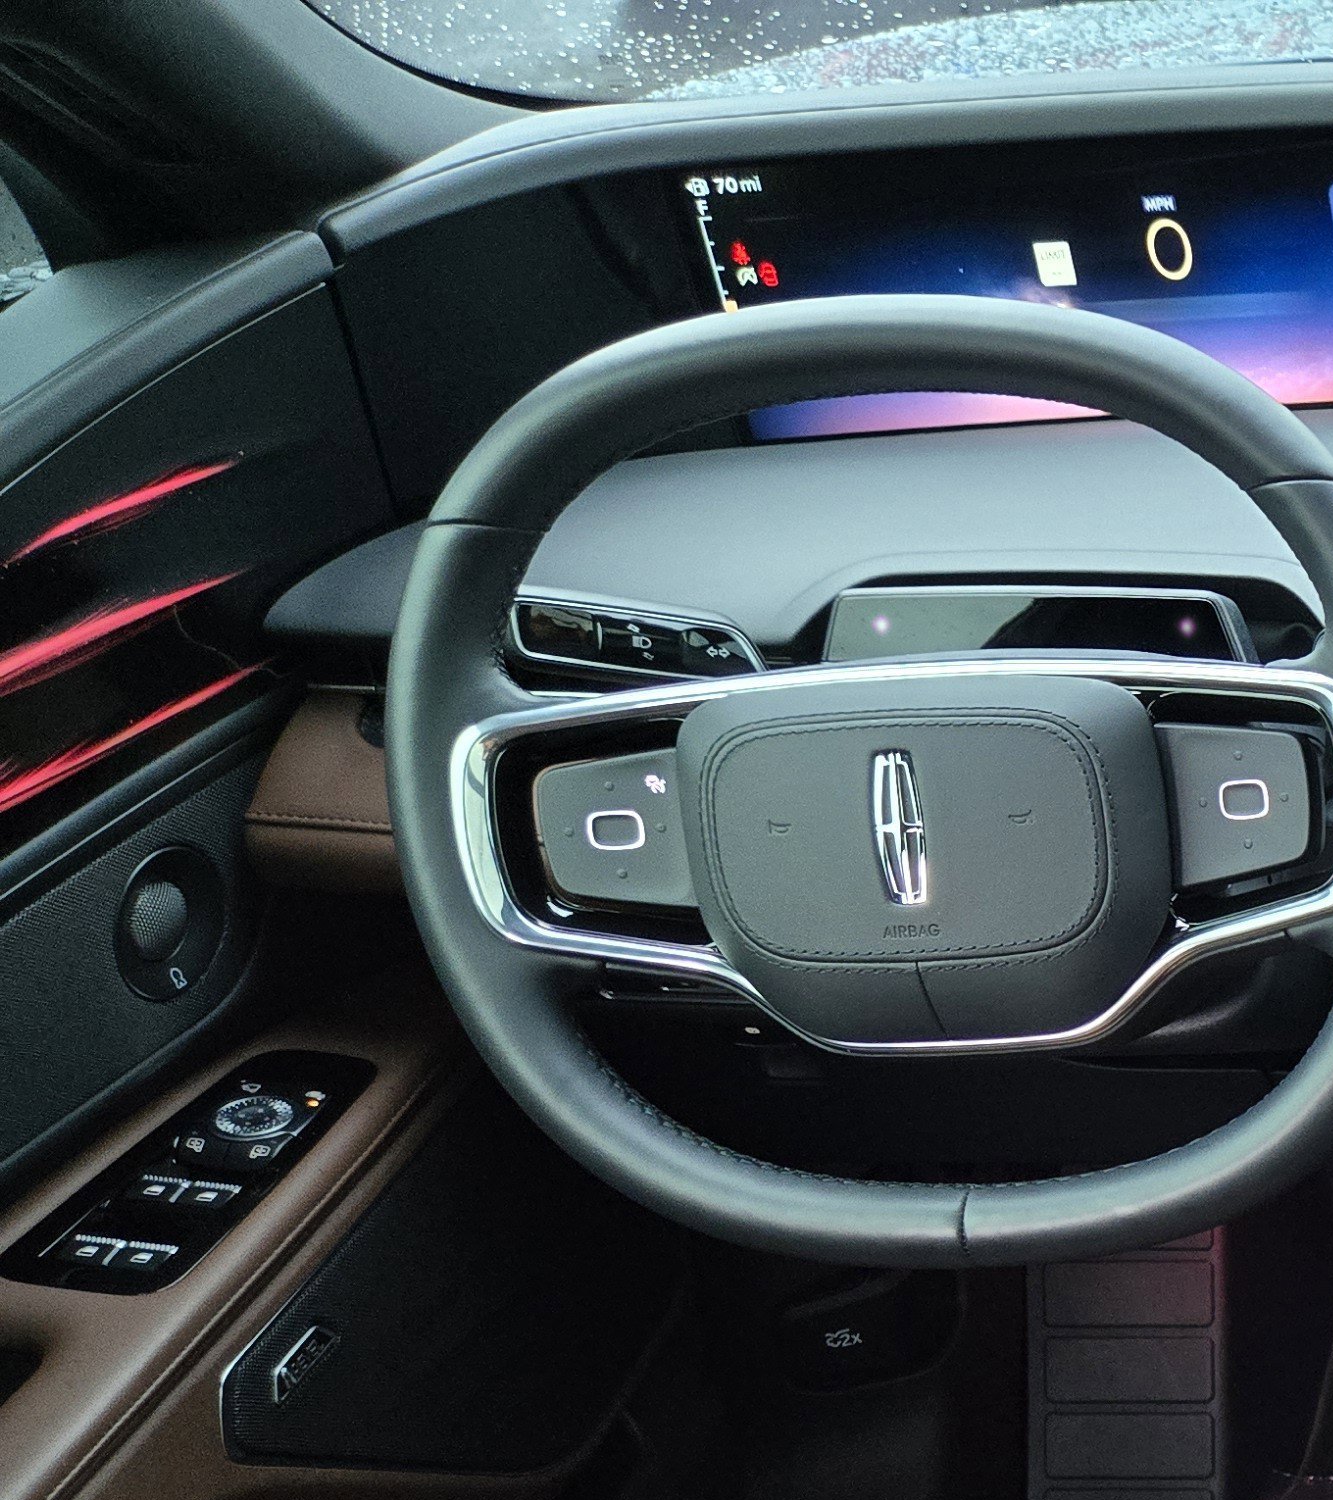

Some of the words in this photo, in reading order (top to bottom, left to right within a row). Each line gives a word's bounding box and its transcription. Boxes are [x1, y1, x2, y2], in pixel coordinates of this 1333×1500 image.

[712, 175, 739, 195] 70
[739, 173, 763, 194] mi
[695, 199, 708, 217] F
[1141, 194, 1178, 213] MPH
[882, 923, 940, 938] AIRBAG
